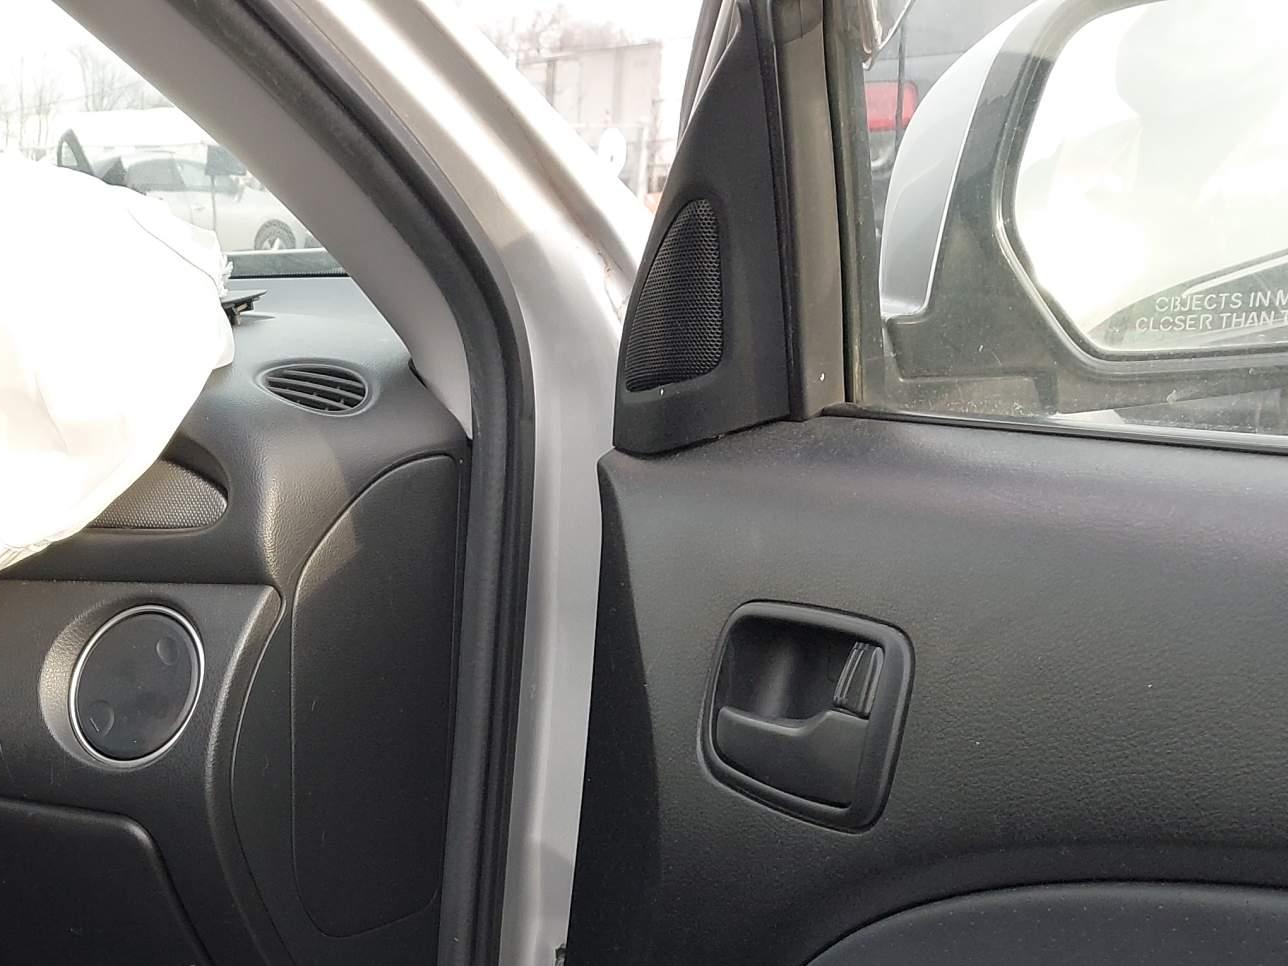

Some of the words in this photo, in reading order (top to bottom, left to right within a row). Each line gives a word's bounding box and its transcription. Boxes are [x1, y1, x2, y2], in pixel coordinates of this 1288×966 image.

[1154, 292, 1243, 312] OBJECTS
[1248, 290, 1271, 308] IN
[1135, 313, 1213, 332] CLOSER
[1219, 310, 1275, 329] THAN
